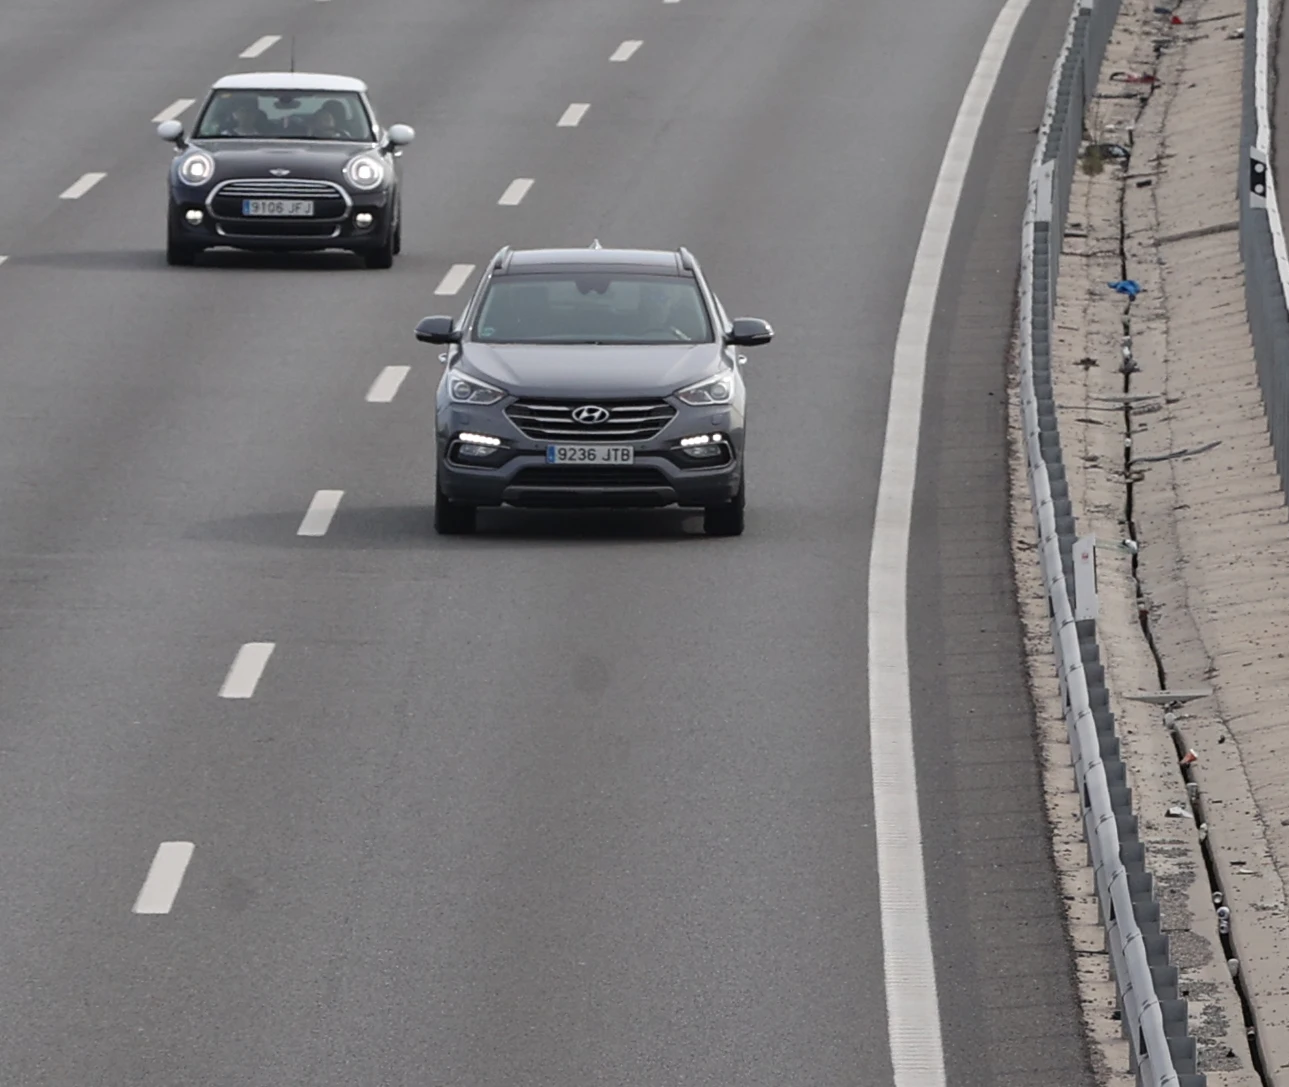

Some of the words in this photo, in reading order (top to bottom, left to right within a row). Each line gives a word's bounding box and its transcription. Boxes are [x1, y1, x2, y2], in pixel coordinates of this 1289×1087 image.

[251, 202, 284, 213] 9106
[557, 448, 597, 462] 9236
[602, 448, 630, 462] JTB
